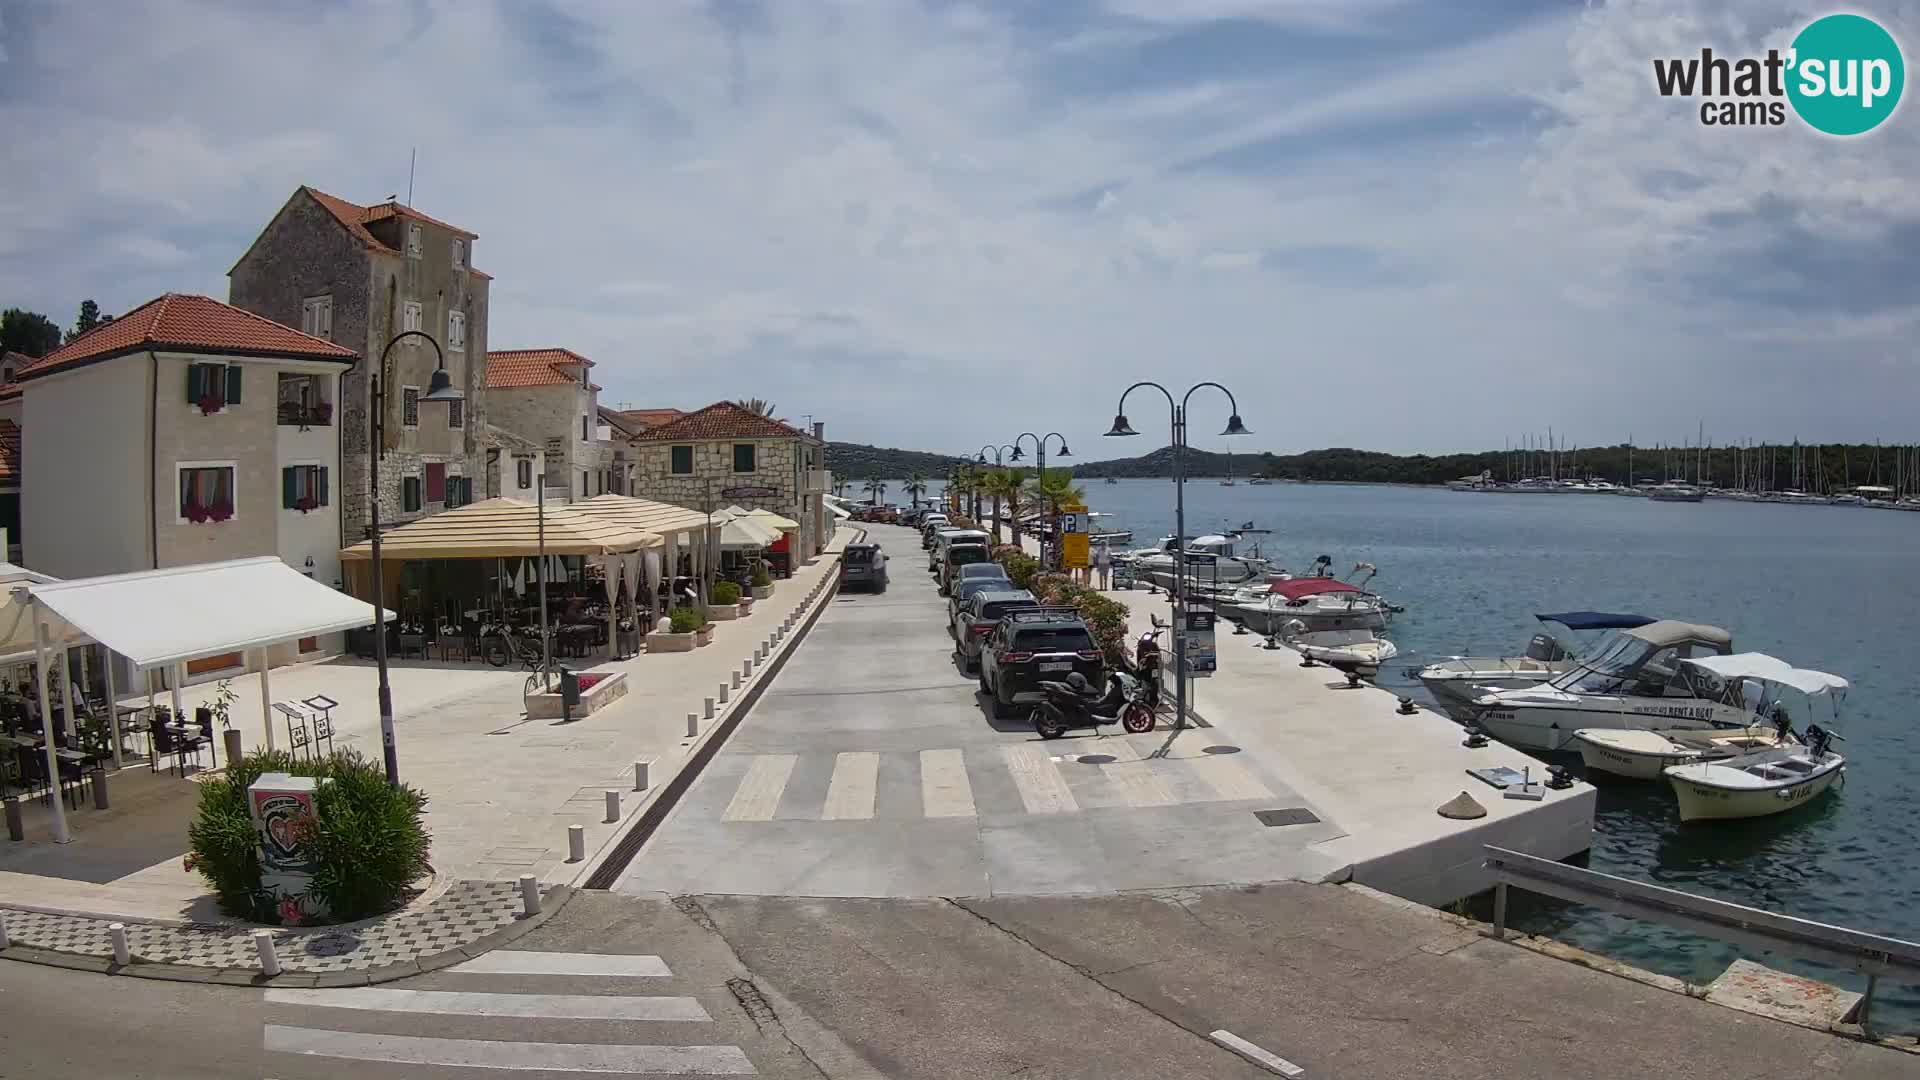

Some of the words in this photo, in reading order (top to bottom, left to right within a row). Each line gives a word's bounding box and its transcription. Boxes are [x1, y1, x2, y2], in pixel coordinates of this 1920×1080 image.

[1065, 515, 1076, 531] P
[1669, 706, 1688, 718] RENT
[1689, 708, 1694, 717] A
[1696, 707, 1714, 720] BOAT
